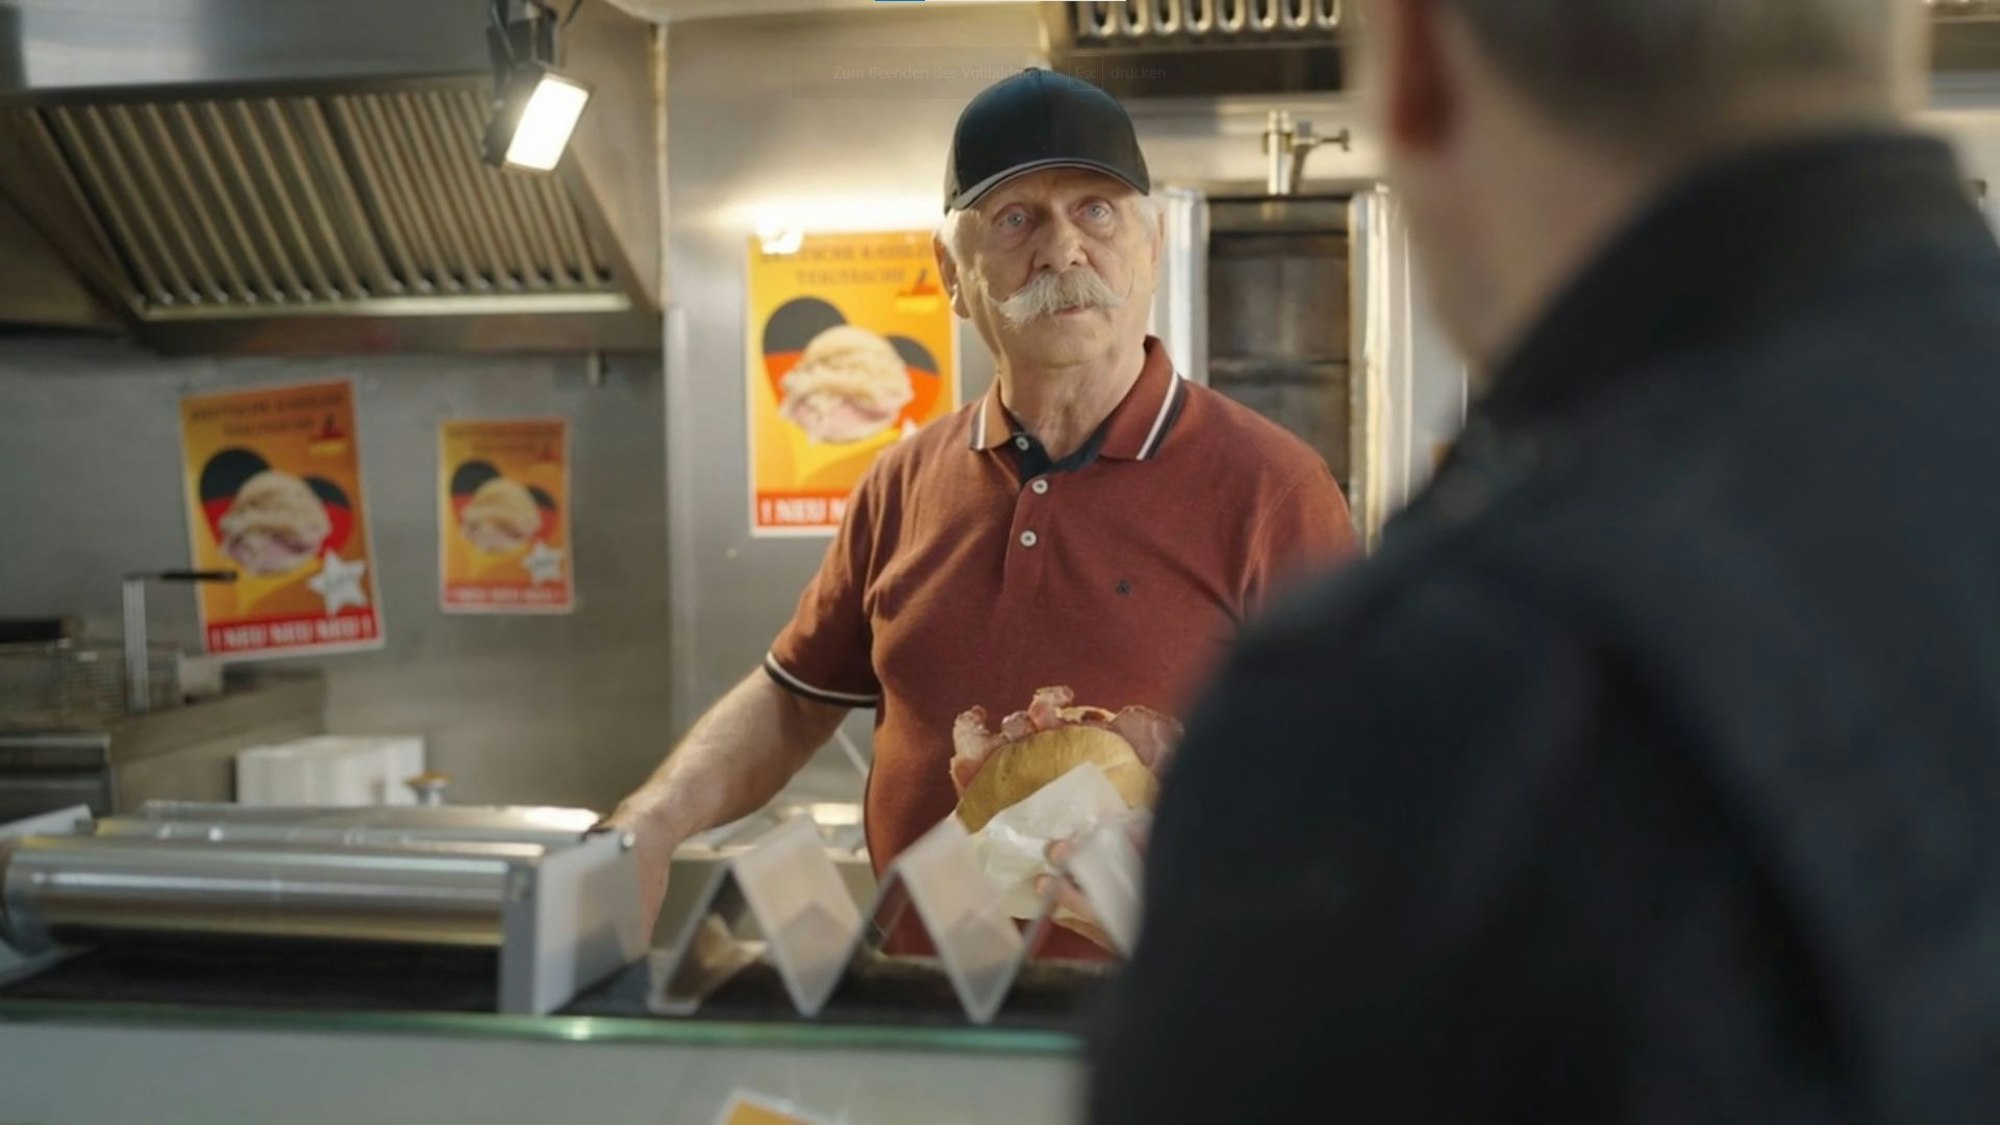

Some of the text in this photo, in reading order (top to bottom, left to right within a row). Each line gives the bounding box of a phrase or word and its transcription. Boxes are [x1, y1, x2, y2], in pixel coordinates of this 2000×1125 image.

[775, 497, 826, 521] NEU
[224, 626, 266, 648] NEU
[271, 621, 313, 643] NEU
[317, 617, 359, 639] NEU
